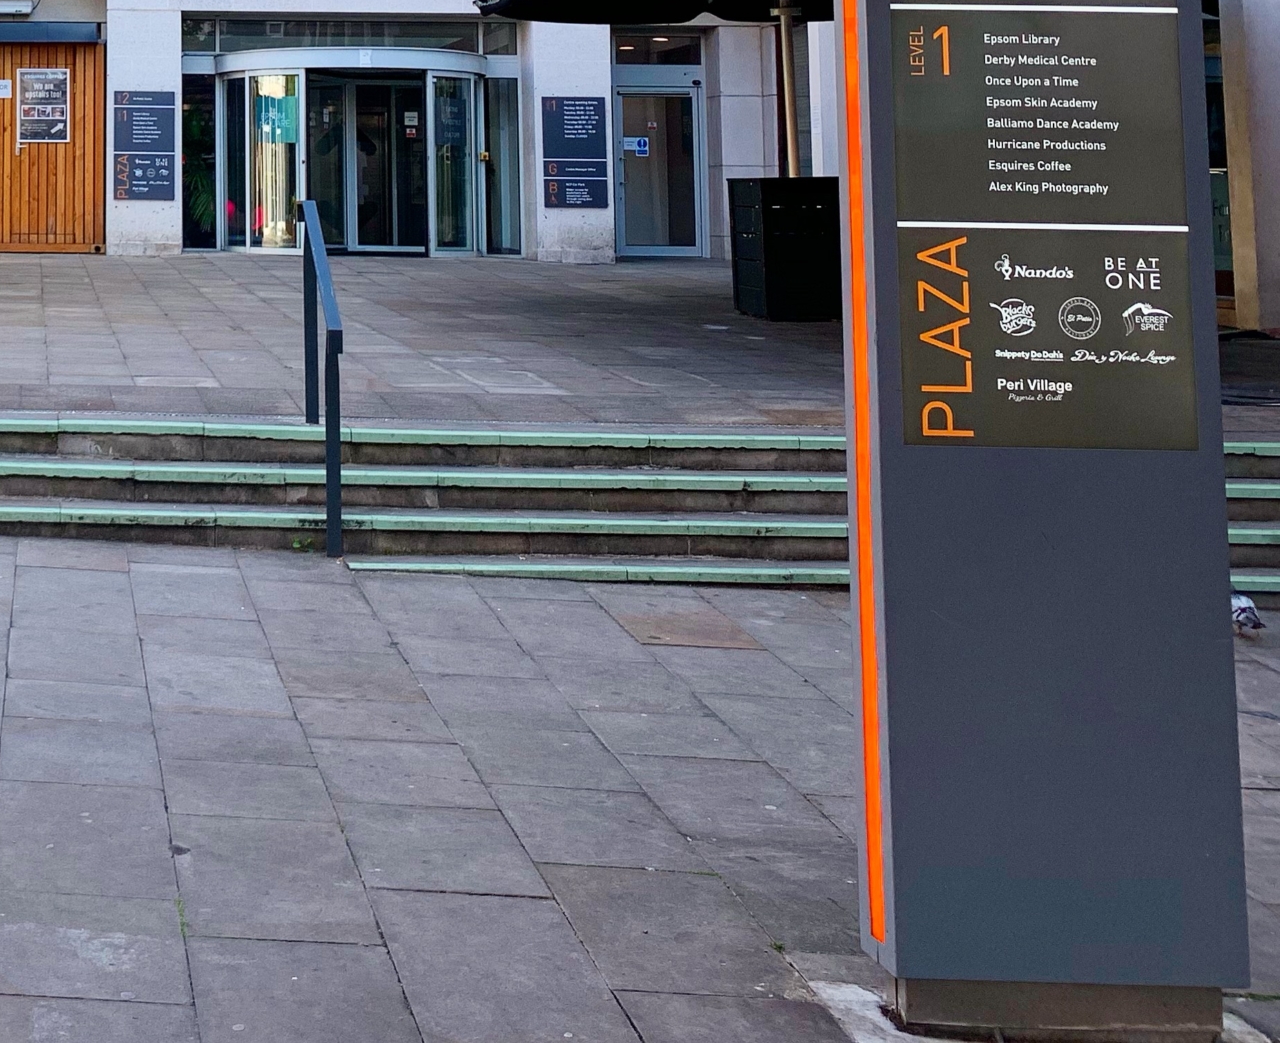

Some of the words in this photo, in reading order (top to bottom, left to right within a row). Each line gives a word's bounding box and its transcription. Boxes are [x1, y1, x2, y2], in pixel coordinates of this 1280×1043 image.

[984, 33, 1019, 45] Epsom
[1022, 34, 1060, 46] Library
[909, 26, 925, 75] LEVEL
[933, 25, 950, 75] 1
[984, 54, 1016, 67] Derby
[1018, 55, 1059, 65] Medical
[1061, 56, 1097, 66] Centre
[985, 76, 1011, 86] Once
[1014, 76, 1041, 88] Upon
[1043, 78, 1050, 86] a
[1052, 77, 1079, 86] Time
[986, 97, 1022, 109] Epsom
[1024, 97, 1048, 108] Skin
[1050, 98, 1098, 110] Academy
[987, 118, 1034, 128] Balliamo
[1036, 118, 1069, 129] Dance
[1071, 119, 1119, 131] Academy
[987, 139, 1040, 149] Hurricane
[1043, 139, 1106, 150] Productions
[988, 160, 1035, 172] Esquires
[1037, 161, 1072, 171] Coffee
[117, 154, 129, 198] PLAZA
[988, 181, 1013, 191] Alex
[1015, 182, 1039, 194] King
[1041, 182, 1109, 195] Photography
[1104, 257, 1126, 270] BE
[1136, 258, 1159, 269] AT
[1014, 265, 1074, 278] Nando's
[1105, 272, 1161, 289] ONE
[1000, 303, 1035, 323] Blacks
[1000, 317, 1036, 333] burgers
[1135, 316, 1169, 324] EVEREST
[1140, 323, 1165, 331] SPICE
[916, 236, 974, 437] PLAZA
[995, 349, 1030, 359] Snippety
[997, 378, 1024, 390] Peri
[1027, 379, 1073, 394] Village
